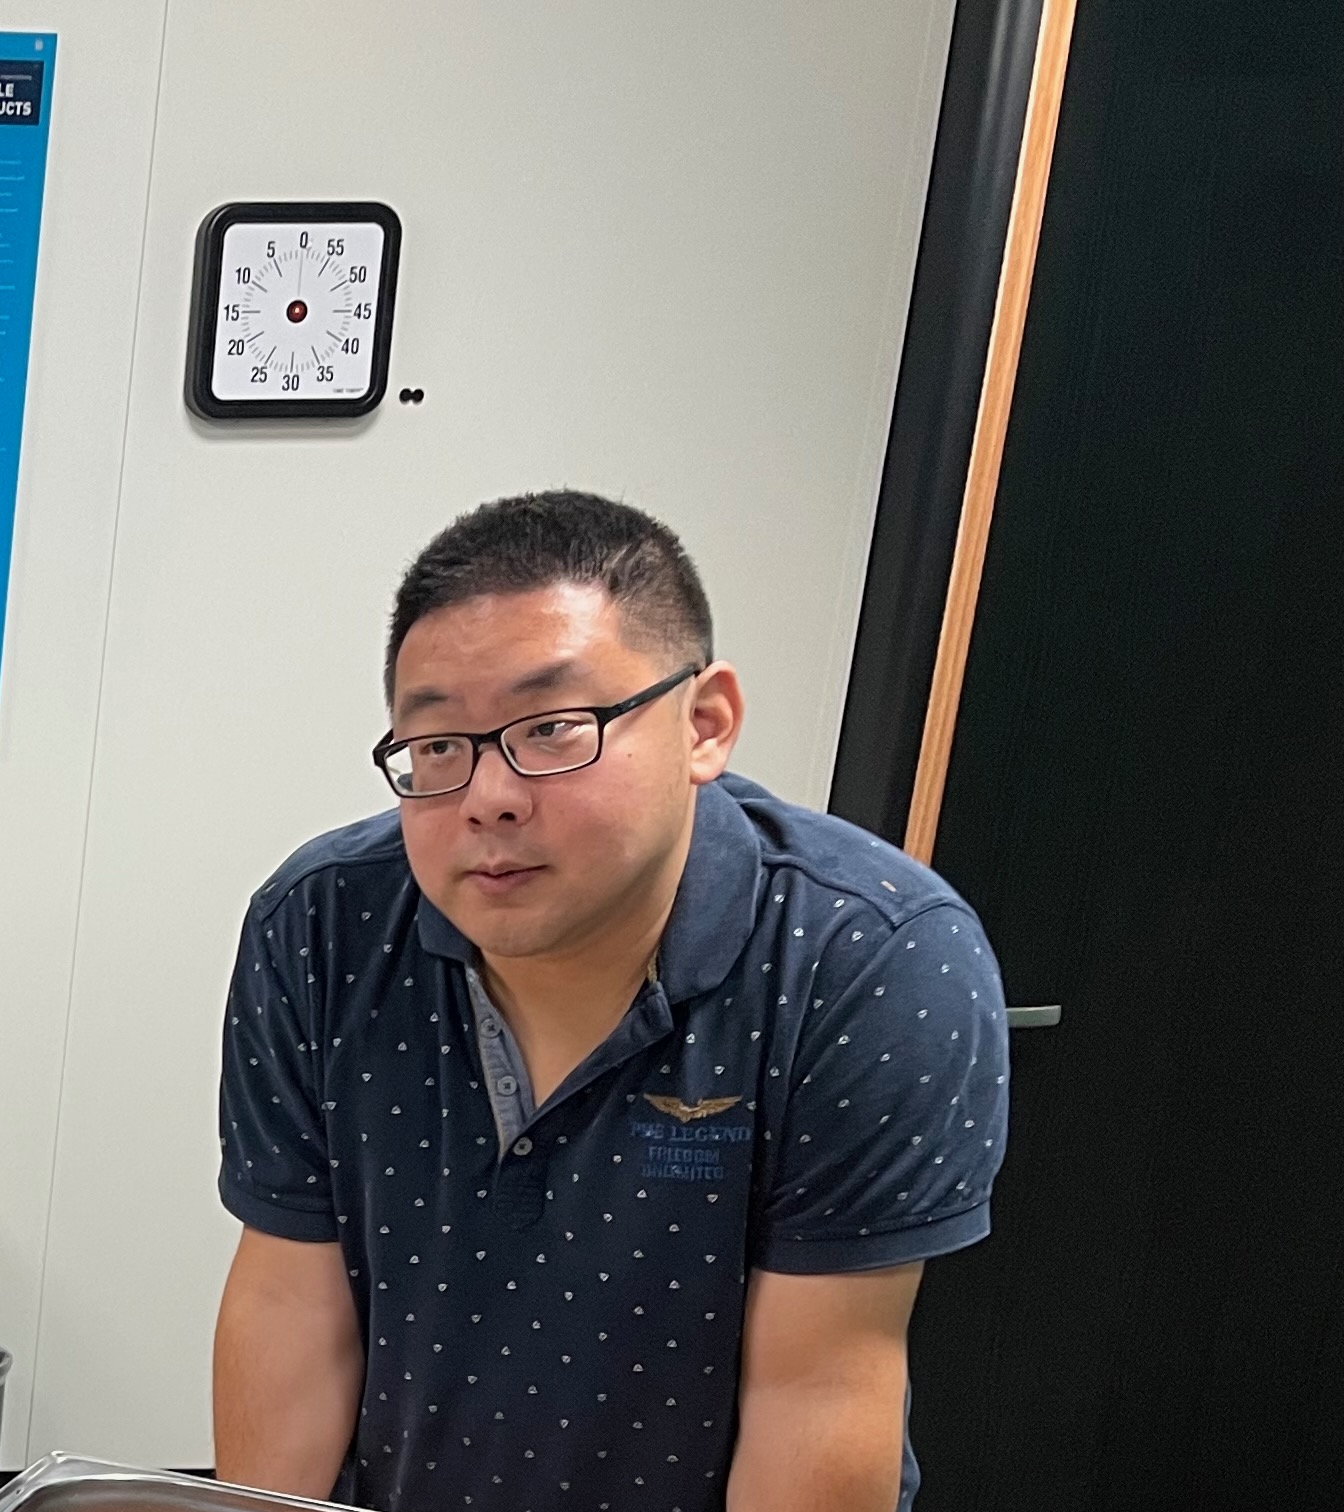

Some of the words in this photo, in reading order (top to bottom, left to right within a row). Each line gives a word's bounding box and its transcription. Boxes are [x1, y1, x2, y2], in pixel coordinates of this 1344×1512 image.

[300, 231, 309, 249] 0
[327, 239, 345, 256] 55
[266, 241, 276, 258] 5
[235, 267, 251, 284] 10
[349, 266, 367, 283] 50
[223, 304, 240, 321] 15
[353, 303, 372, 320] 45
[227, 339, 245, 356] 20
[341, 338, 360, 354] 40
[250, 366, 268, 383] 25
[316, 365, 334, 382] 35
[281, 375, 300, 391] 30
[669, 1126, 752, 1143] LEGEND
